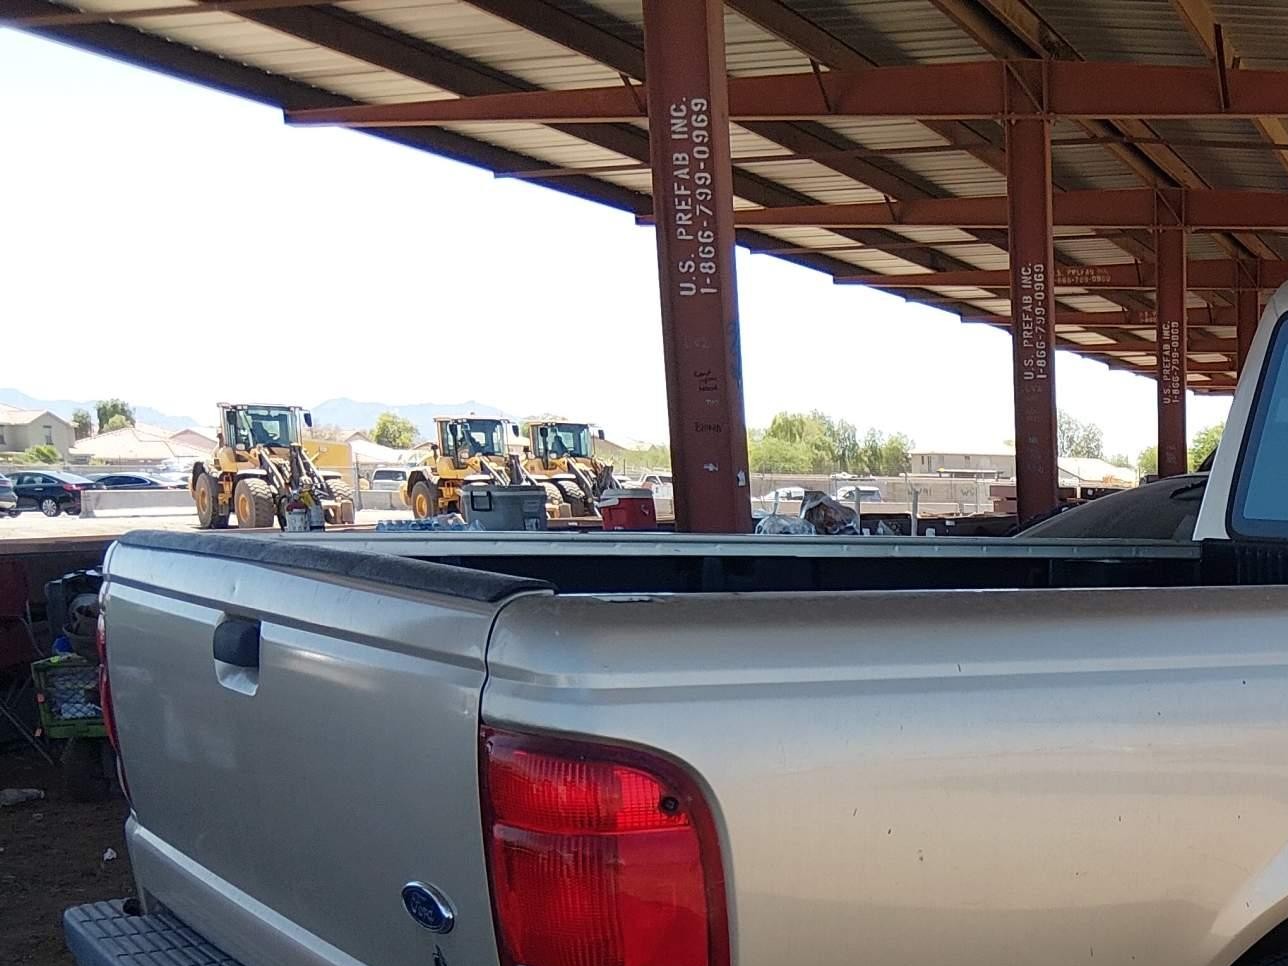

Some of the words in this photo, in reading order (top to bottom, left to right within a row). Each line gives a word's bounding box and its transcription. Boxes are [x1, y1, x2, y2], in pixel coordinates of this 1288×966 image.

[670, 96, 689, 140] INC.
[672, 152, 694, 240] PREFAB
[690, 97, 718, 294] 1-866-799-0969
[678, 253, 697, 296] U.S.
[1021, 262, 1033, 289] INC.
[1022, 295, 1034, 347] PREFAB
[1033, 263, 1048, 379] 1-866-799-0969
[1023, 354, 1034, 380] U.S.
[1162, 343, 1171, 381] PREFAB
